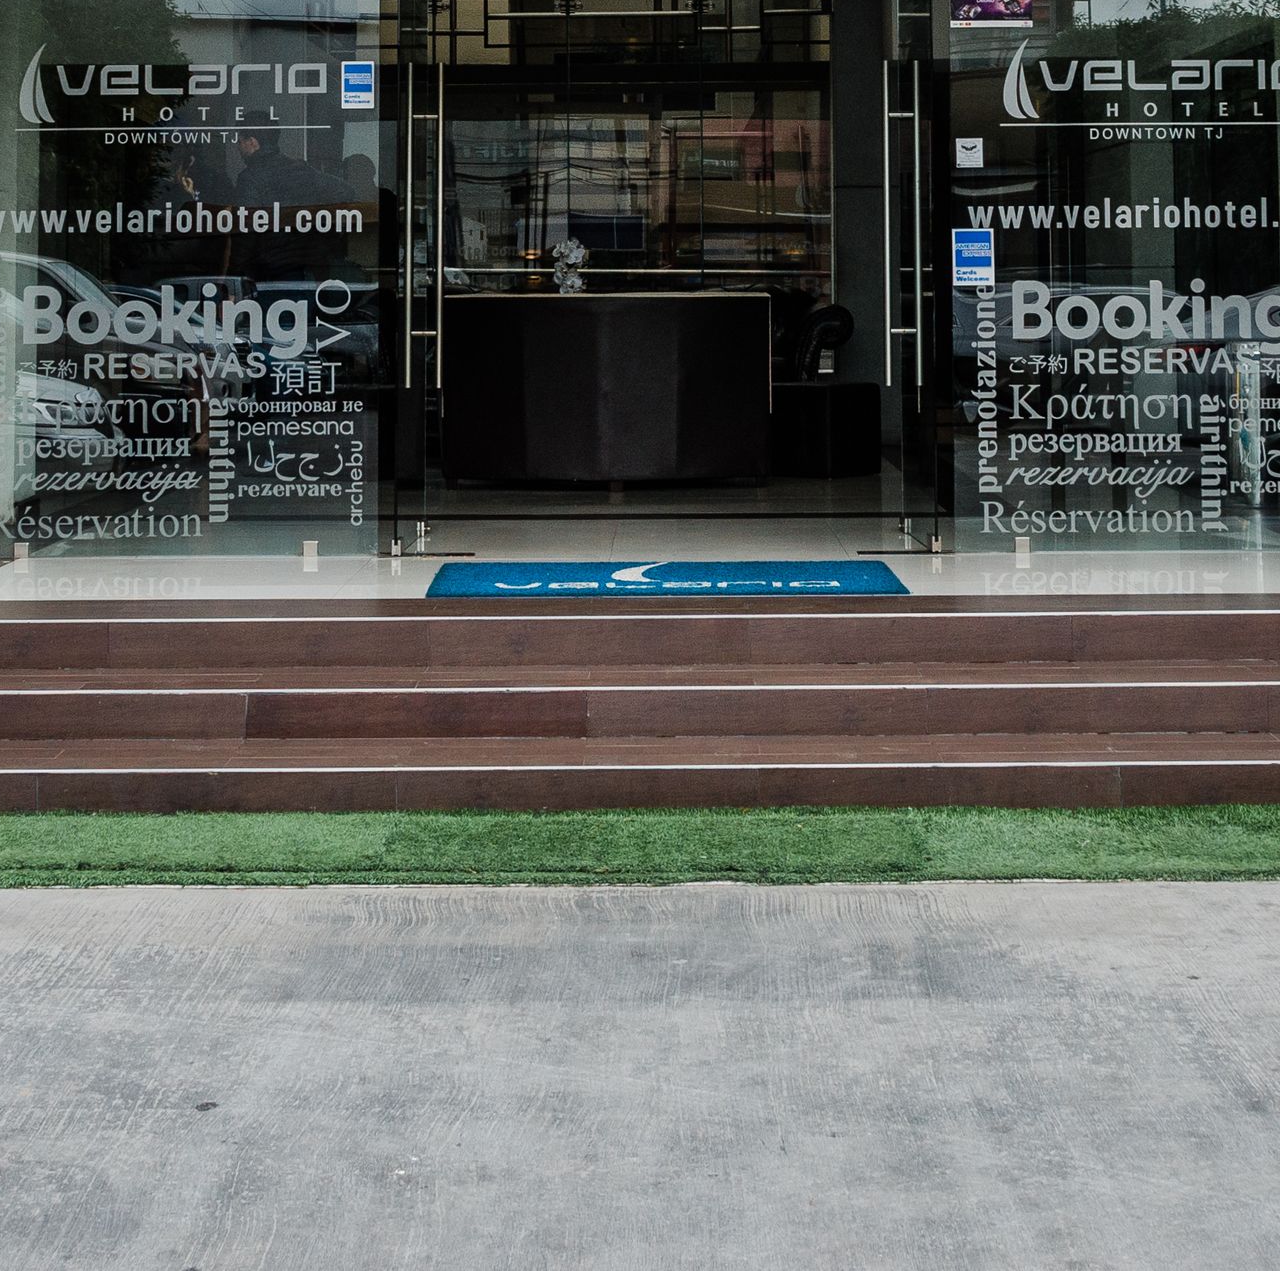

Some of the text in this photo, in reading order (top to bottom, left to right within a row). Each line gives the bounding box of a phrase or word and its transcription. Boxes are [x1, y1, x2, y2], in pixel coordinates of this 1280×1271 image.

[122, 106, 280, 122] HOTEL
[1106, 102, 1263, 117] HOTEL
[104, 131, 239, 145] DOWNTOWN TJ
[1089, 127, 1223, 140] DOWNTOWN TJ
[22, 283, 308, 358] Booking
[83, 353, 266, 379] RESERVAS
[1009, 354, 1068, 375] ご予約
[1073, 348, 1258, 375] RESERVAS
[972, 284, 1002, 493] prenotazione
[1009, 384, 1193, 429] Κράτηση
[237, 420, 353, 441] pemesana
[17, 437, 190, 466] резервация
[1008, 432, 1182, 462] резервация
[14, 463, 202, 502] rezervacija
[238, 483, 342, 497] rezervare
[345, 440, 363, 526] archebu
[1005, 459, 1195, 498] rezervacija
[979, 499, 1196, 534] Réservation
